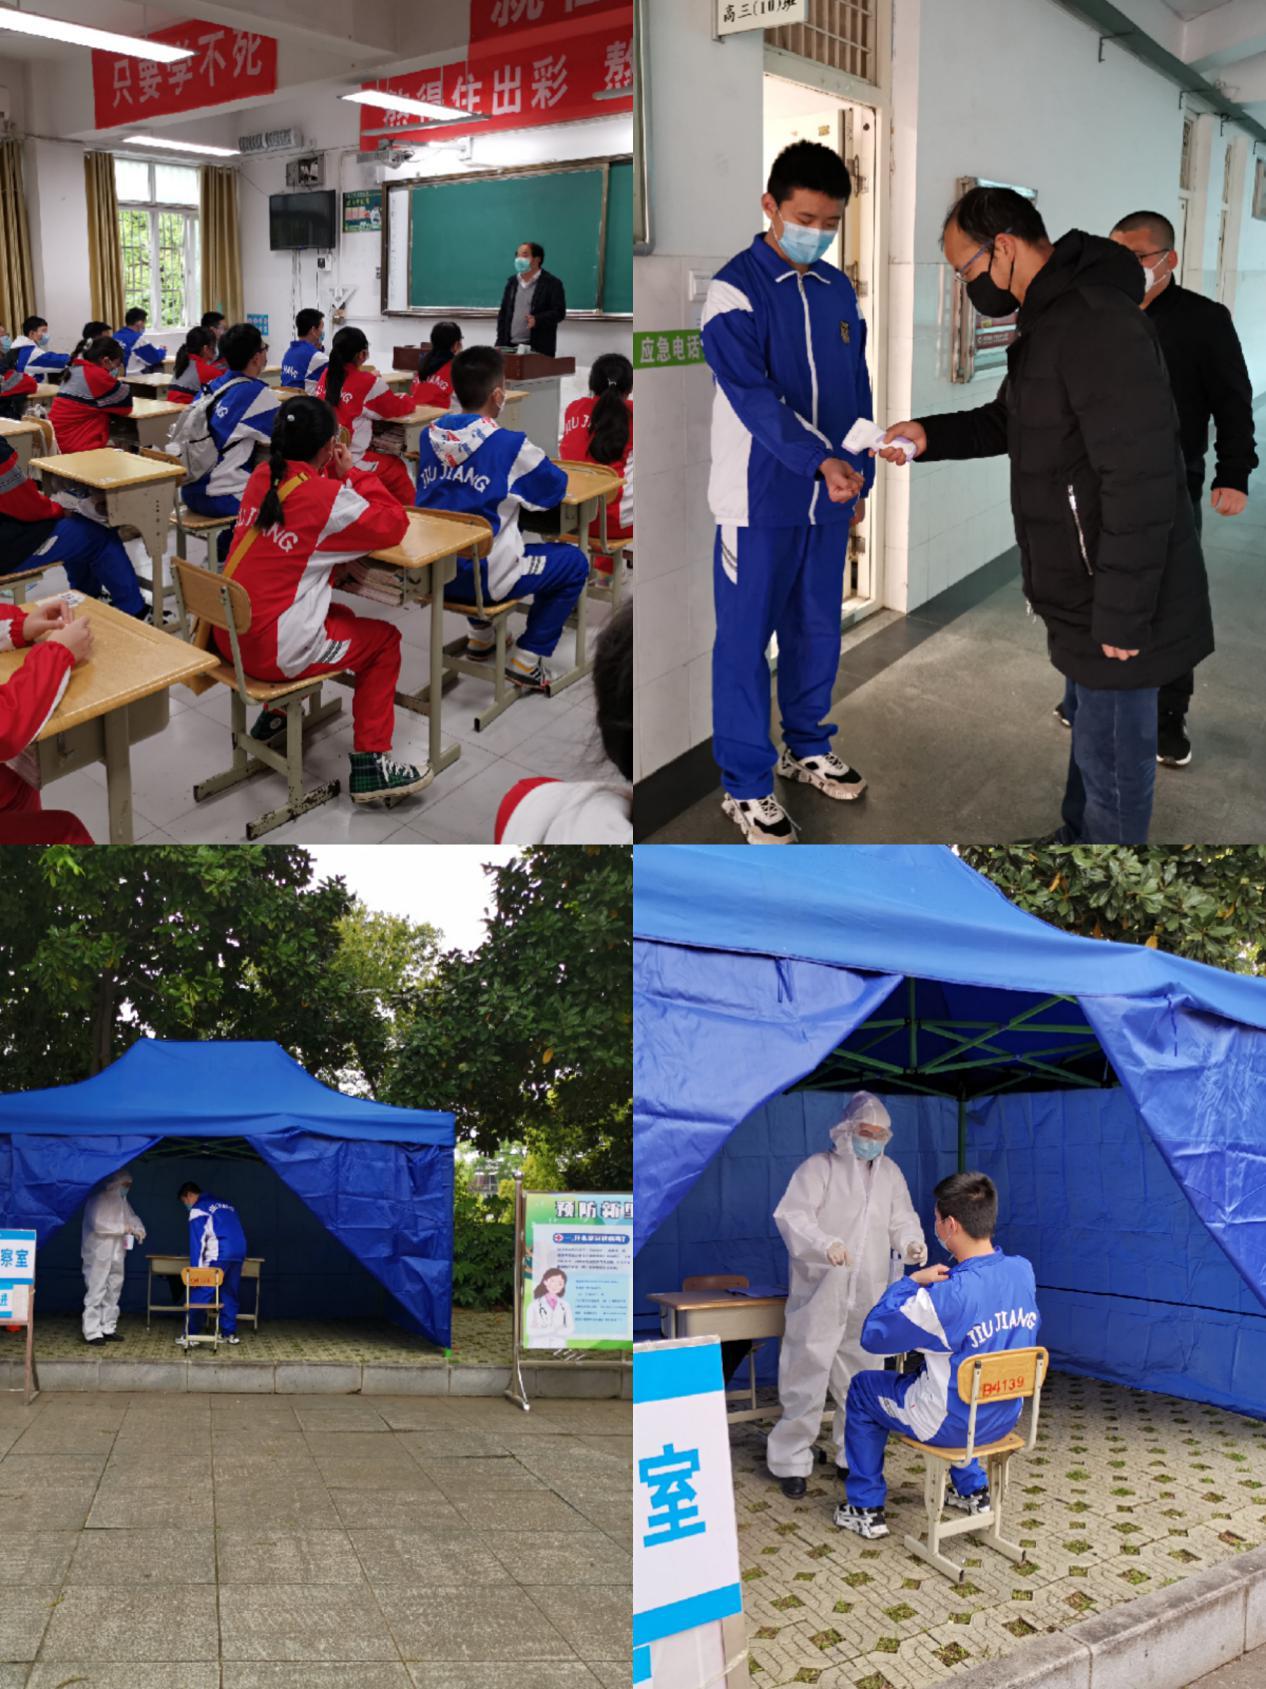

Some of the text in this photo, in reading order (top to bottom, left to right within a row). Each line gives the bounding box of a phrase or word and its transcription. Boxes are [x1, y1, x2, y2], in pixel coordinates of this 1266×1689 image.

[112, 29, 263, 108] 只要学不死
[640, 335, 700, 363] 应急电话
[420, 463, 490, 493] JIU JIANG
[0, 1248, 28, 1268] 察室
[966, 1307, 1038, 1349] JIU JIANG
[981, 1375, 1025, 1398] B4139
[638, 1443, 706, 1548] 室
